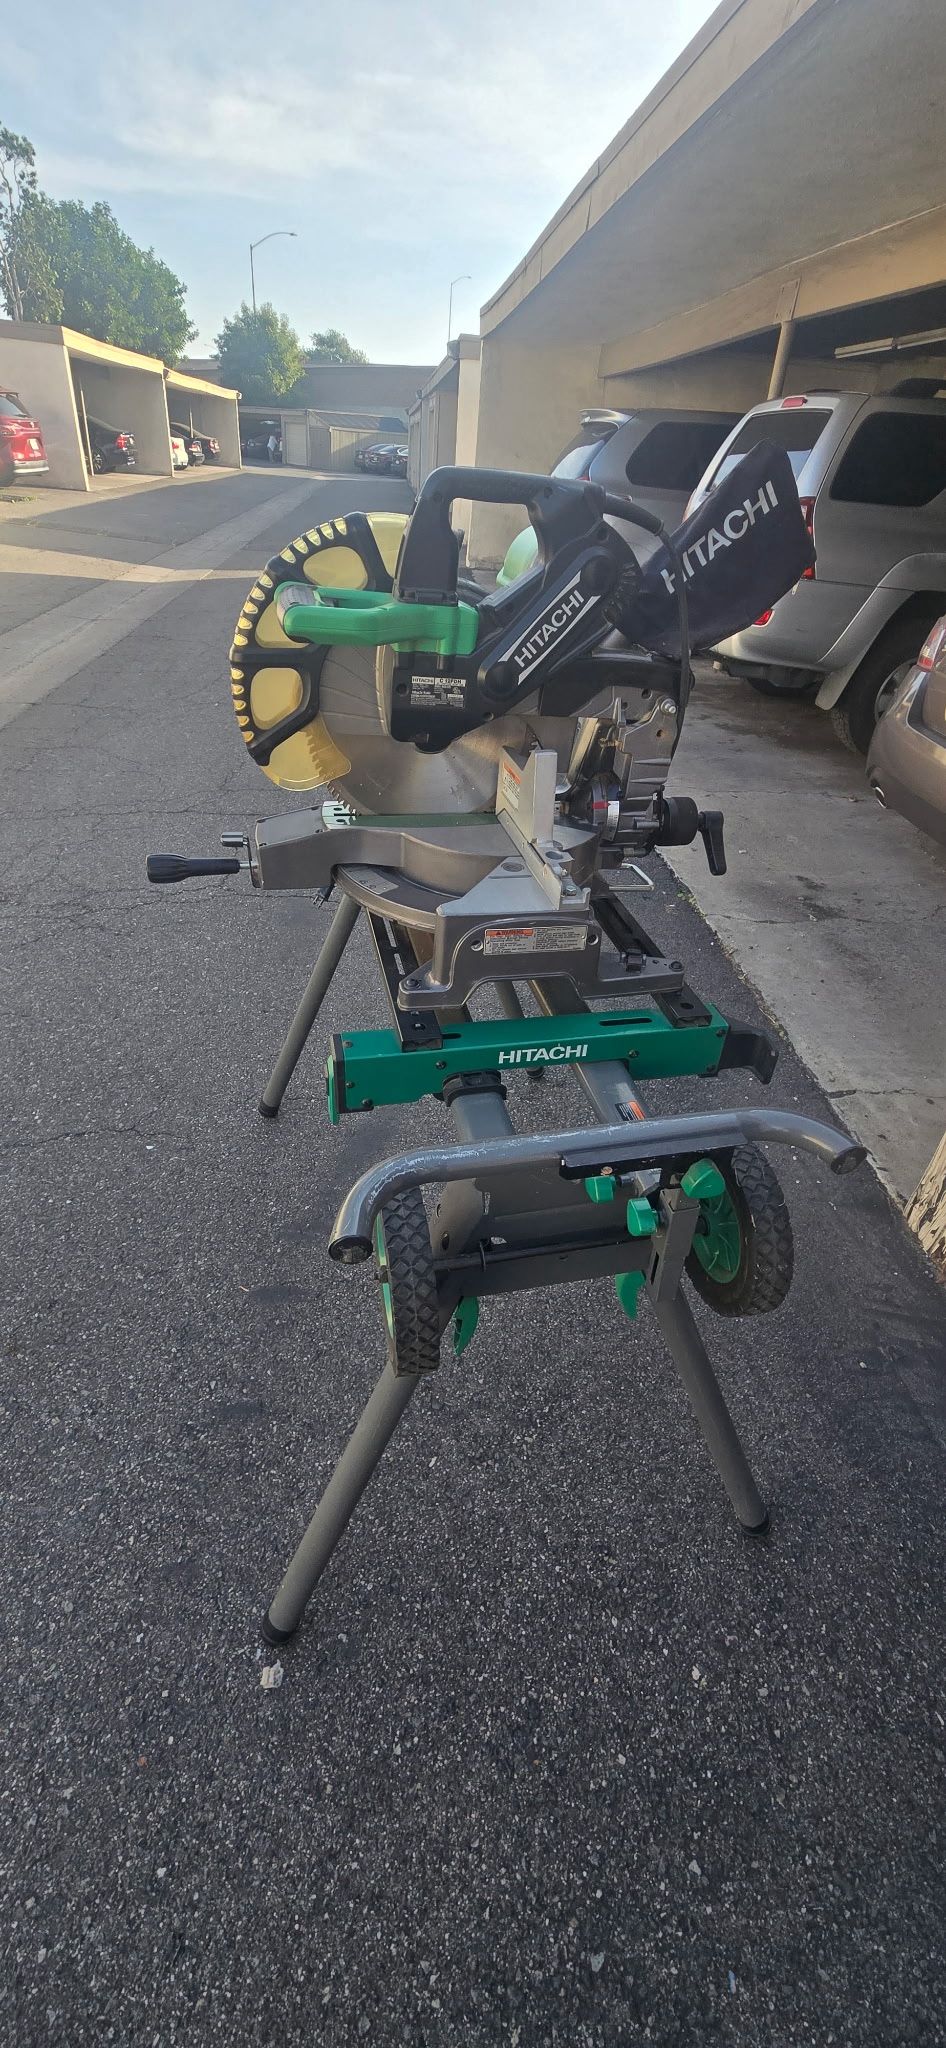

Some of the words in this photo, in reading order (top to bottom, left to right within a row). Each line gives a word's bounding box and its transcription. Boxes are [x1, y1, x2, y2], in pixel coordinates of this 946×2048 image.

[660, 480, 779, 594] HITACHI
[513, 589, 585, 668] HITACHI
[498, 1044, 589, 1065] HITACHI
